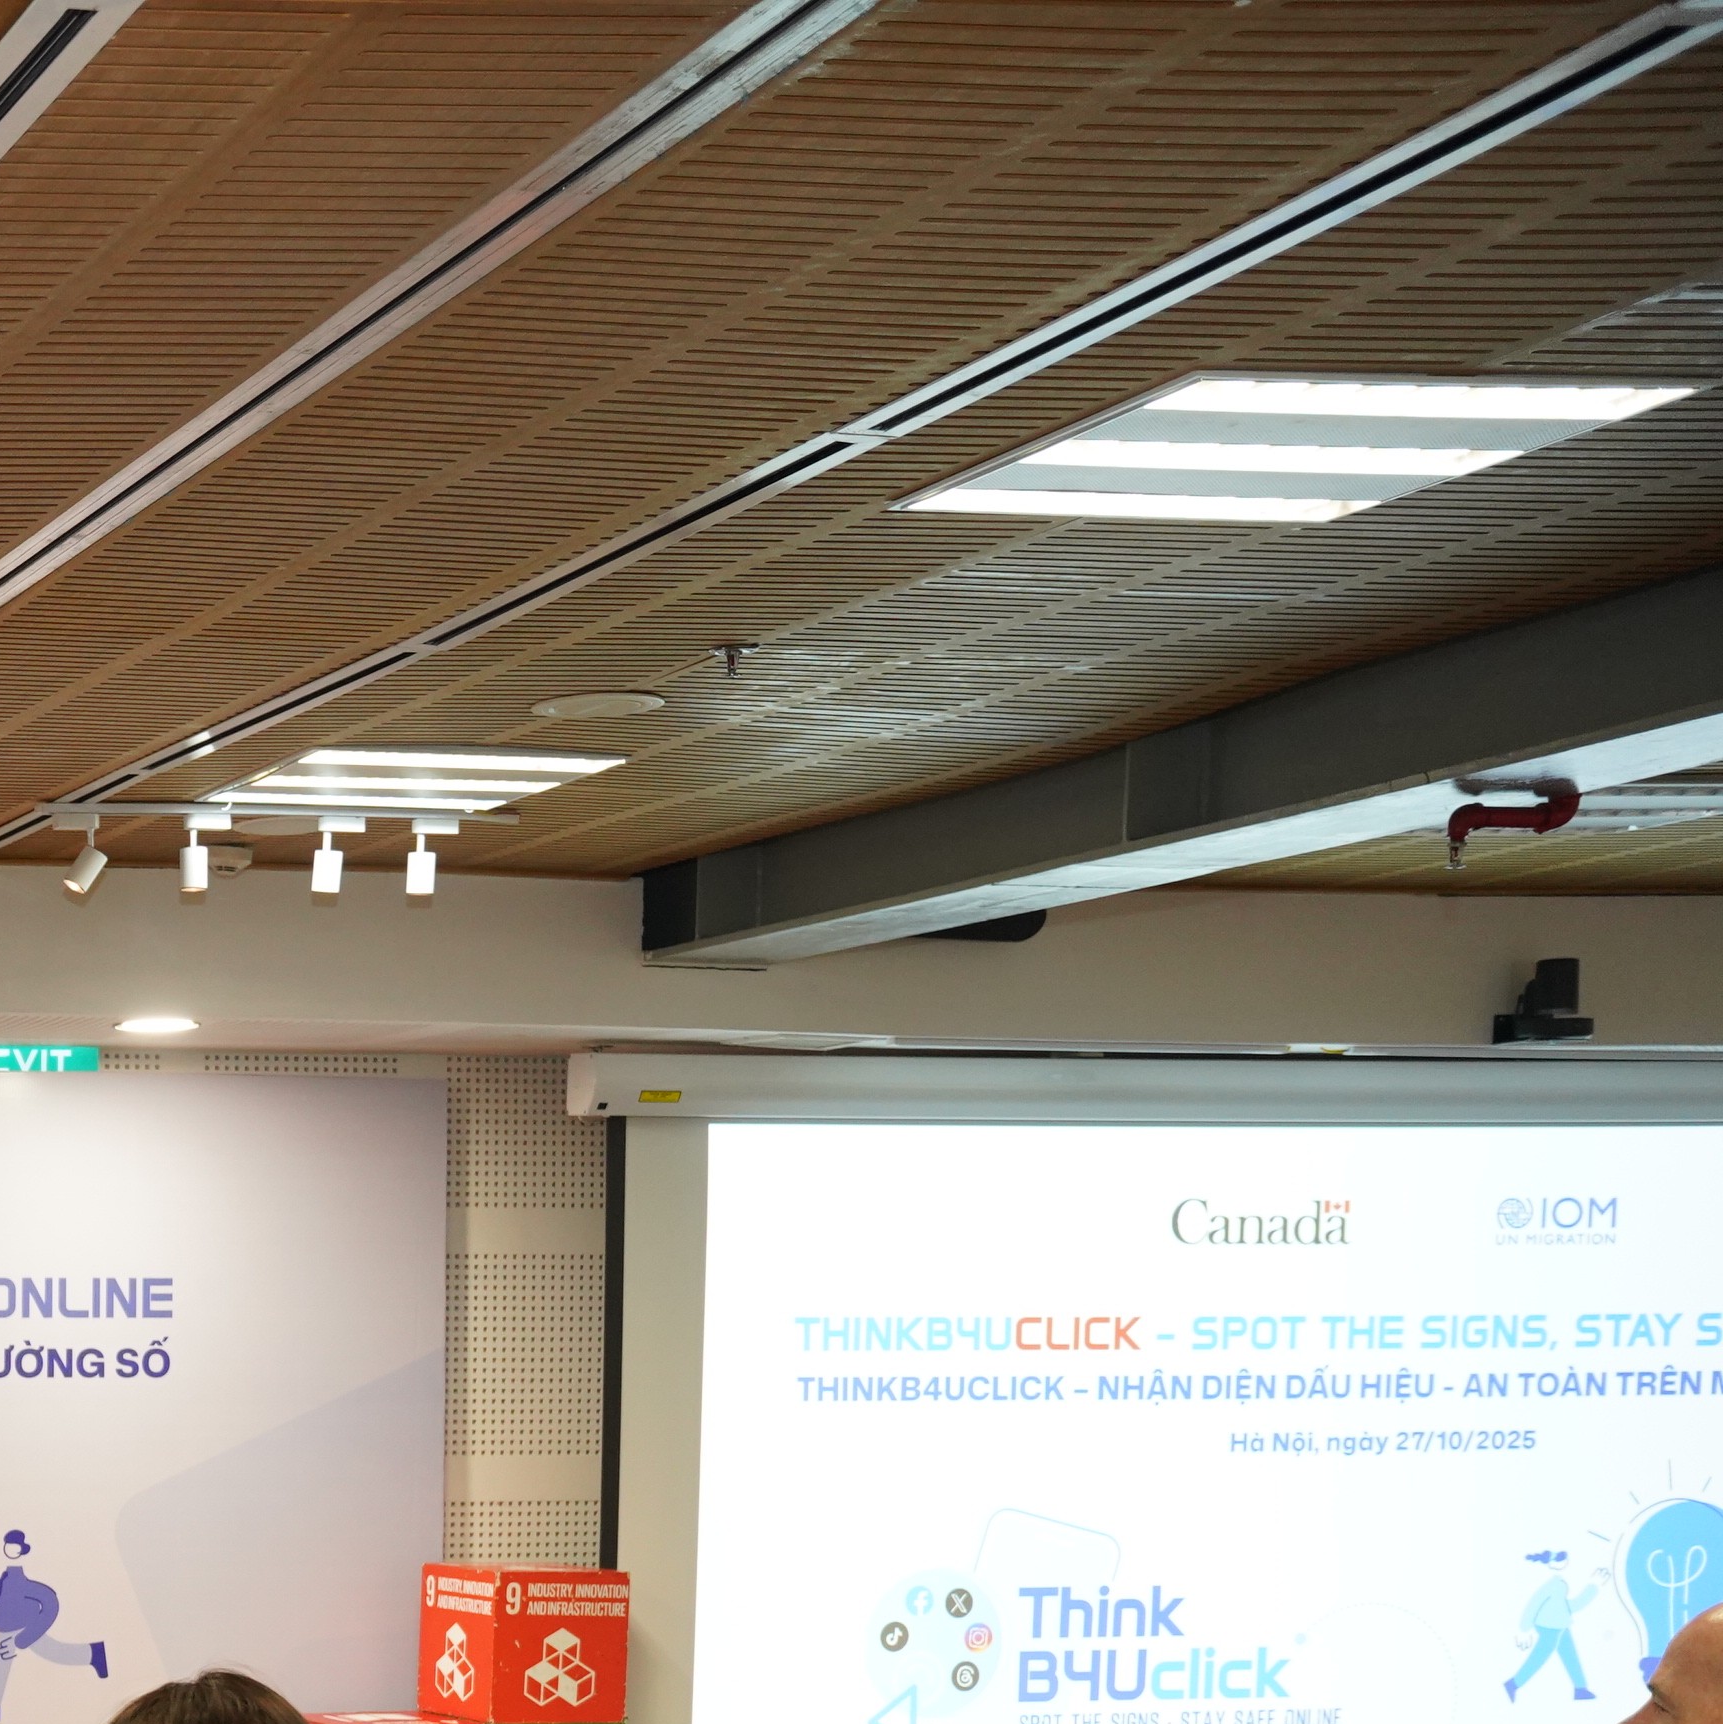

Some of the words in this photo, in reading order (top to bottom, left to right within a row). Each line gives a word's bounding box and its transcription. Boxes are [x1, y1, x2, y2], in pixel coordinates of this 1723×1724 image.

[1172, 1199, 1350, 1245] Canada
[1542, 1197, 1617, 1229] IOM
[1496, 1234, 1519, 1246] UN
[1526, 1232, 1616, 1246] MIGRATION
[796, 1317, 1140, 1350] THINKB4UCLICK
[1192, 1316, 1306, 1350] SPOT
[1322, 1315, 1404, 1349] THE
[1421, 1314, 1557, 1350] SIGNS,
[1575, 1313, 1682, 1347] STAY
[116, 1337, 170, 1378] SỐ
[797, 1376, 1063, 1401] THINKB4UCLICK
[1098, 1367, 1193, 1405] NHẬN
[1202, 1369, 1276, 1404] DIỆN
[1286, 1364, 1352, 1400] DẤU
[1361, 1366, 1435, 1404] HIỆU
[1463, 1373, 1508, 1397] AN
[1518, 1366, 1607, 1397] TOÀN
[1616, 1365, 1702, 1395] TRÊN
[1230, 1433, 1264, 1453] Hà
[1272, 1431, 1320, 1457] Nội,
[1327, 1432, 1388, 1456] ngày
[1396, 1430, 1536, 1452] 27/10/2025
[426, 1575, 435, 1607] 9
[505, 1582, 521, 1615] 9
[1019, 1585, 1184, 1638] Think
[1018, 1647, 1288, 1702] B4Uclick
